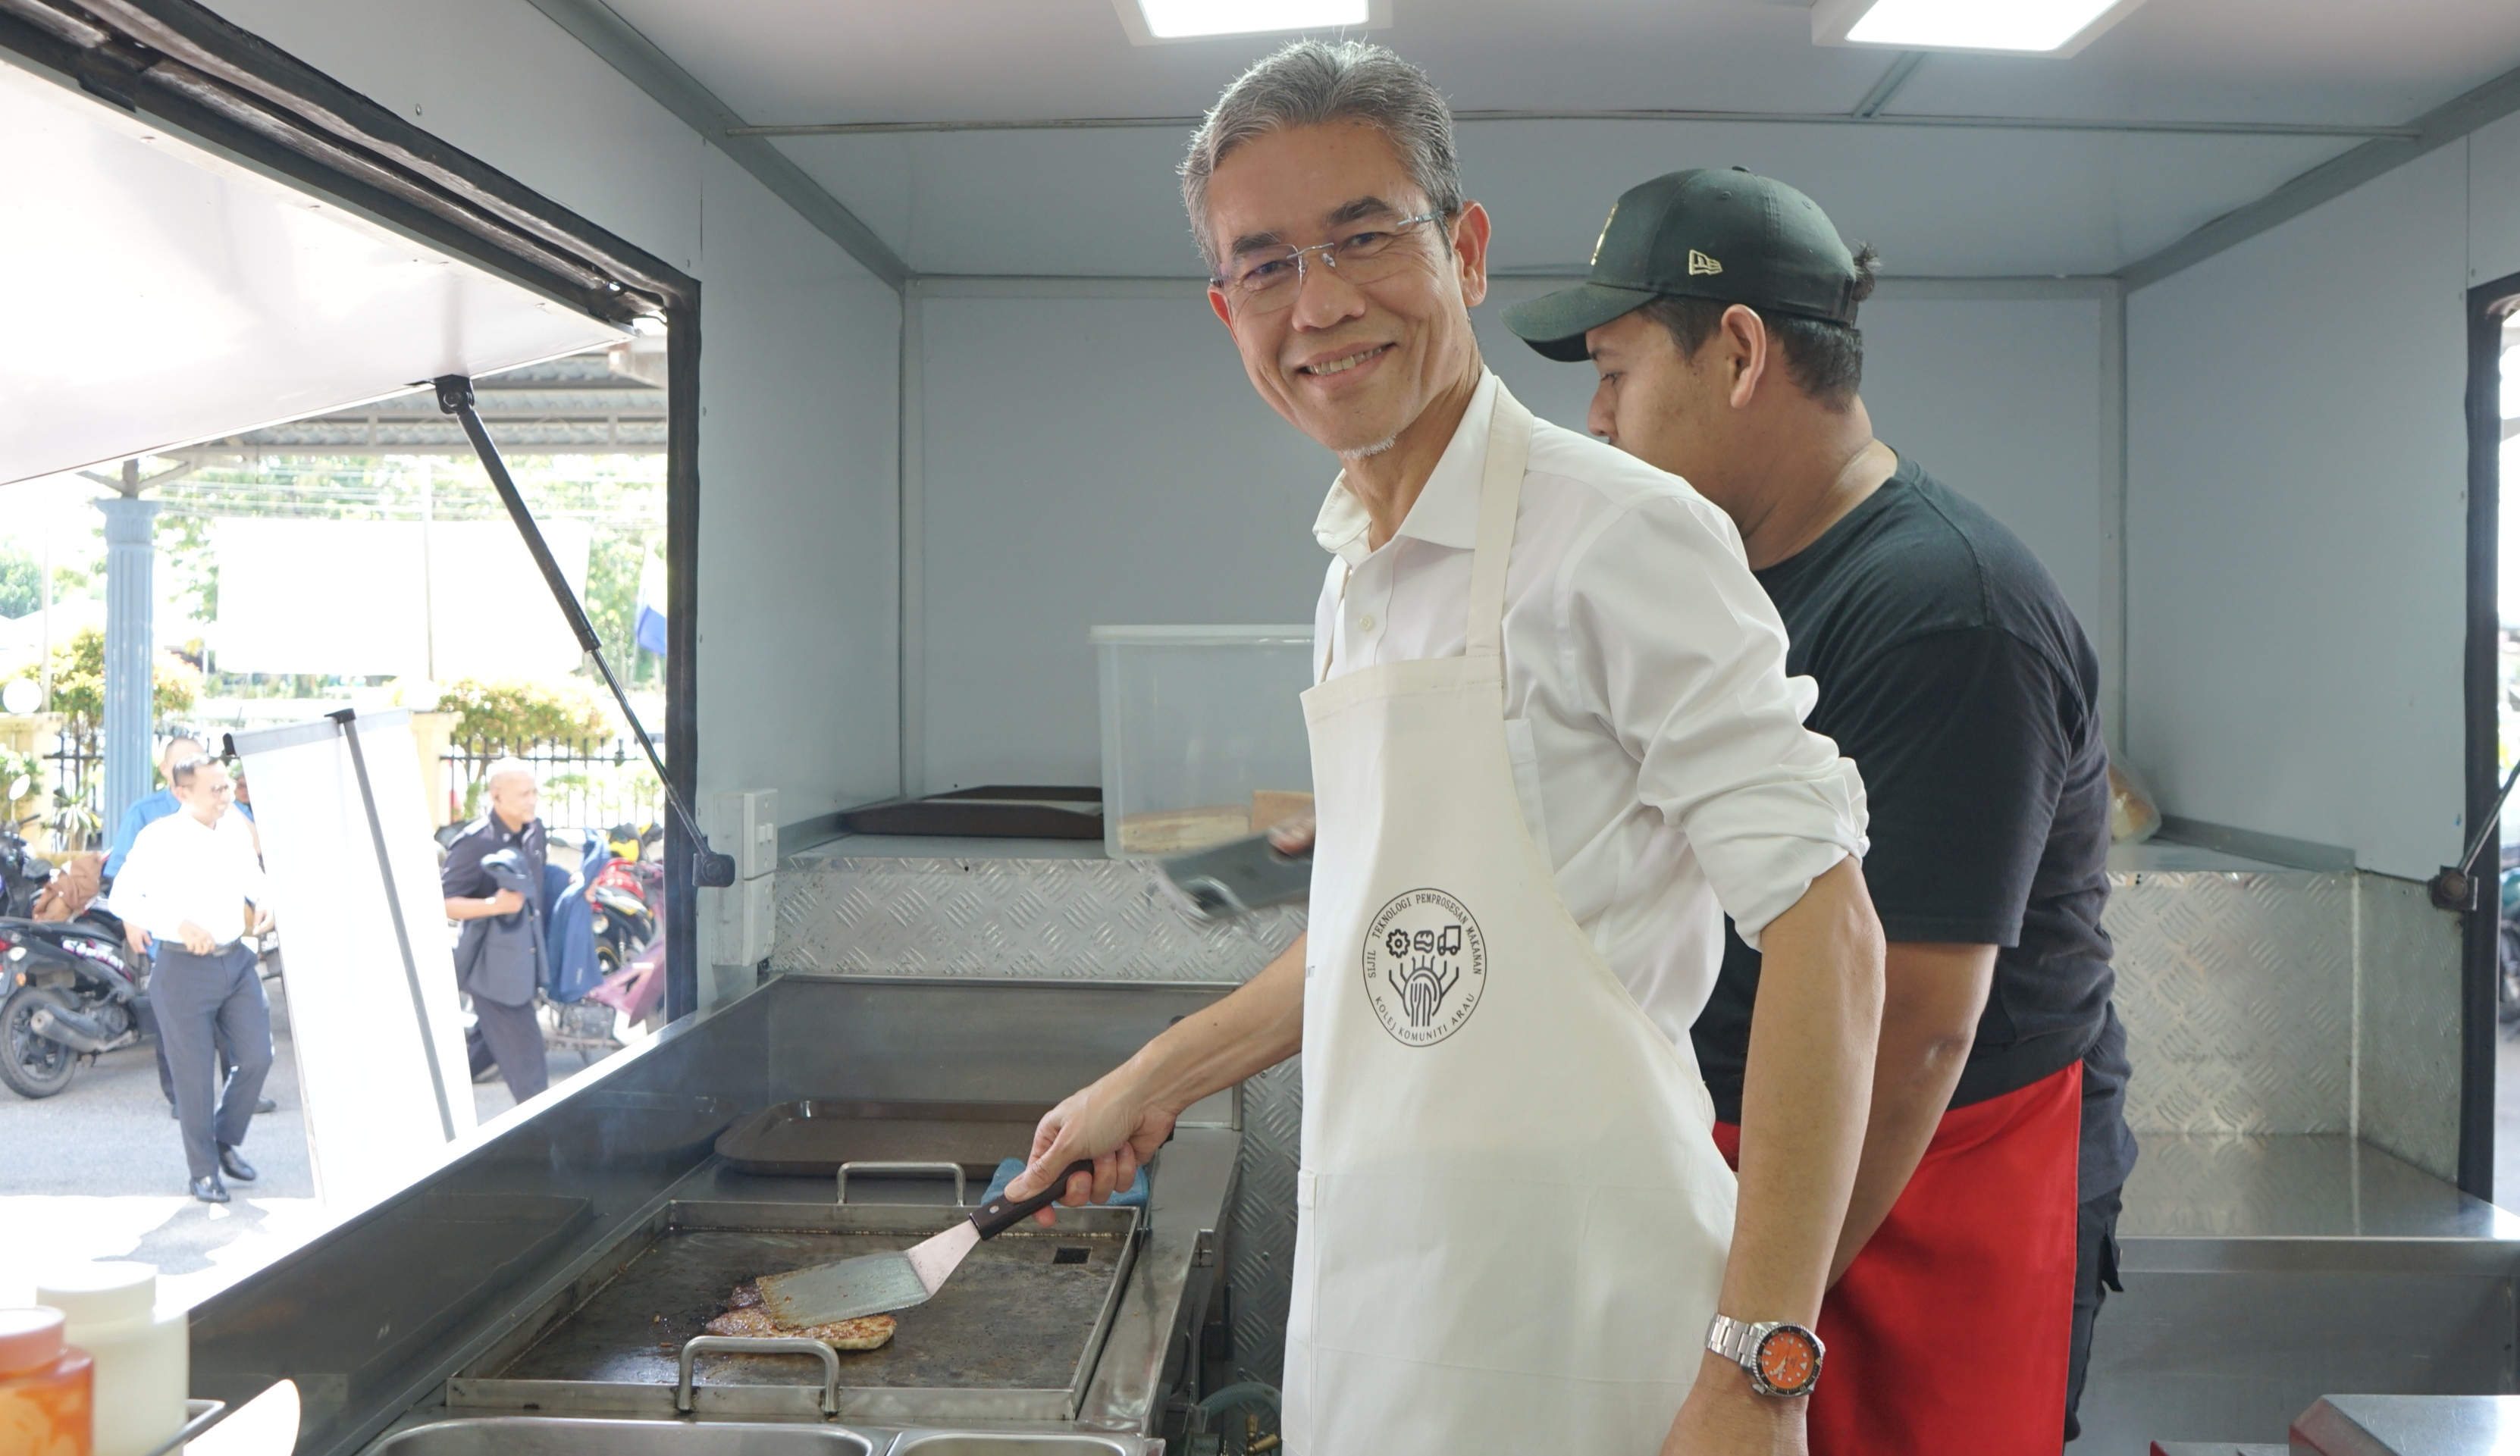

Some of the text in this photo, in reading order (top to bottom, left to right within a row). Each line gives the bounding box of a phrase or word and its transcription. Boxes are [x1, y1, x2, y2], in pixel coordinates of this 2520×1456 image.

[1367, 893, 1481, 978] SIJIL TEKNOLOGI PEMPROSESAN MAKANAN
[1374, 993, 1475, 1041] KOLEJ KOMUNITI ARAU
